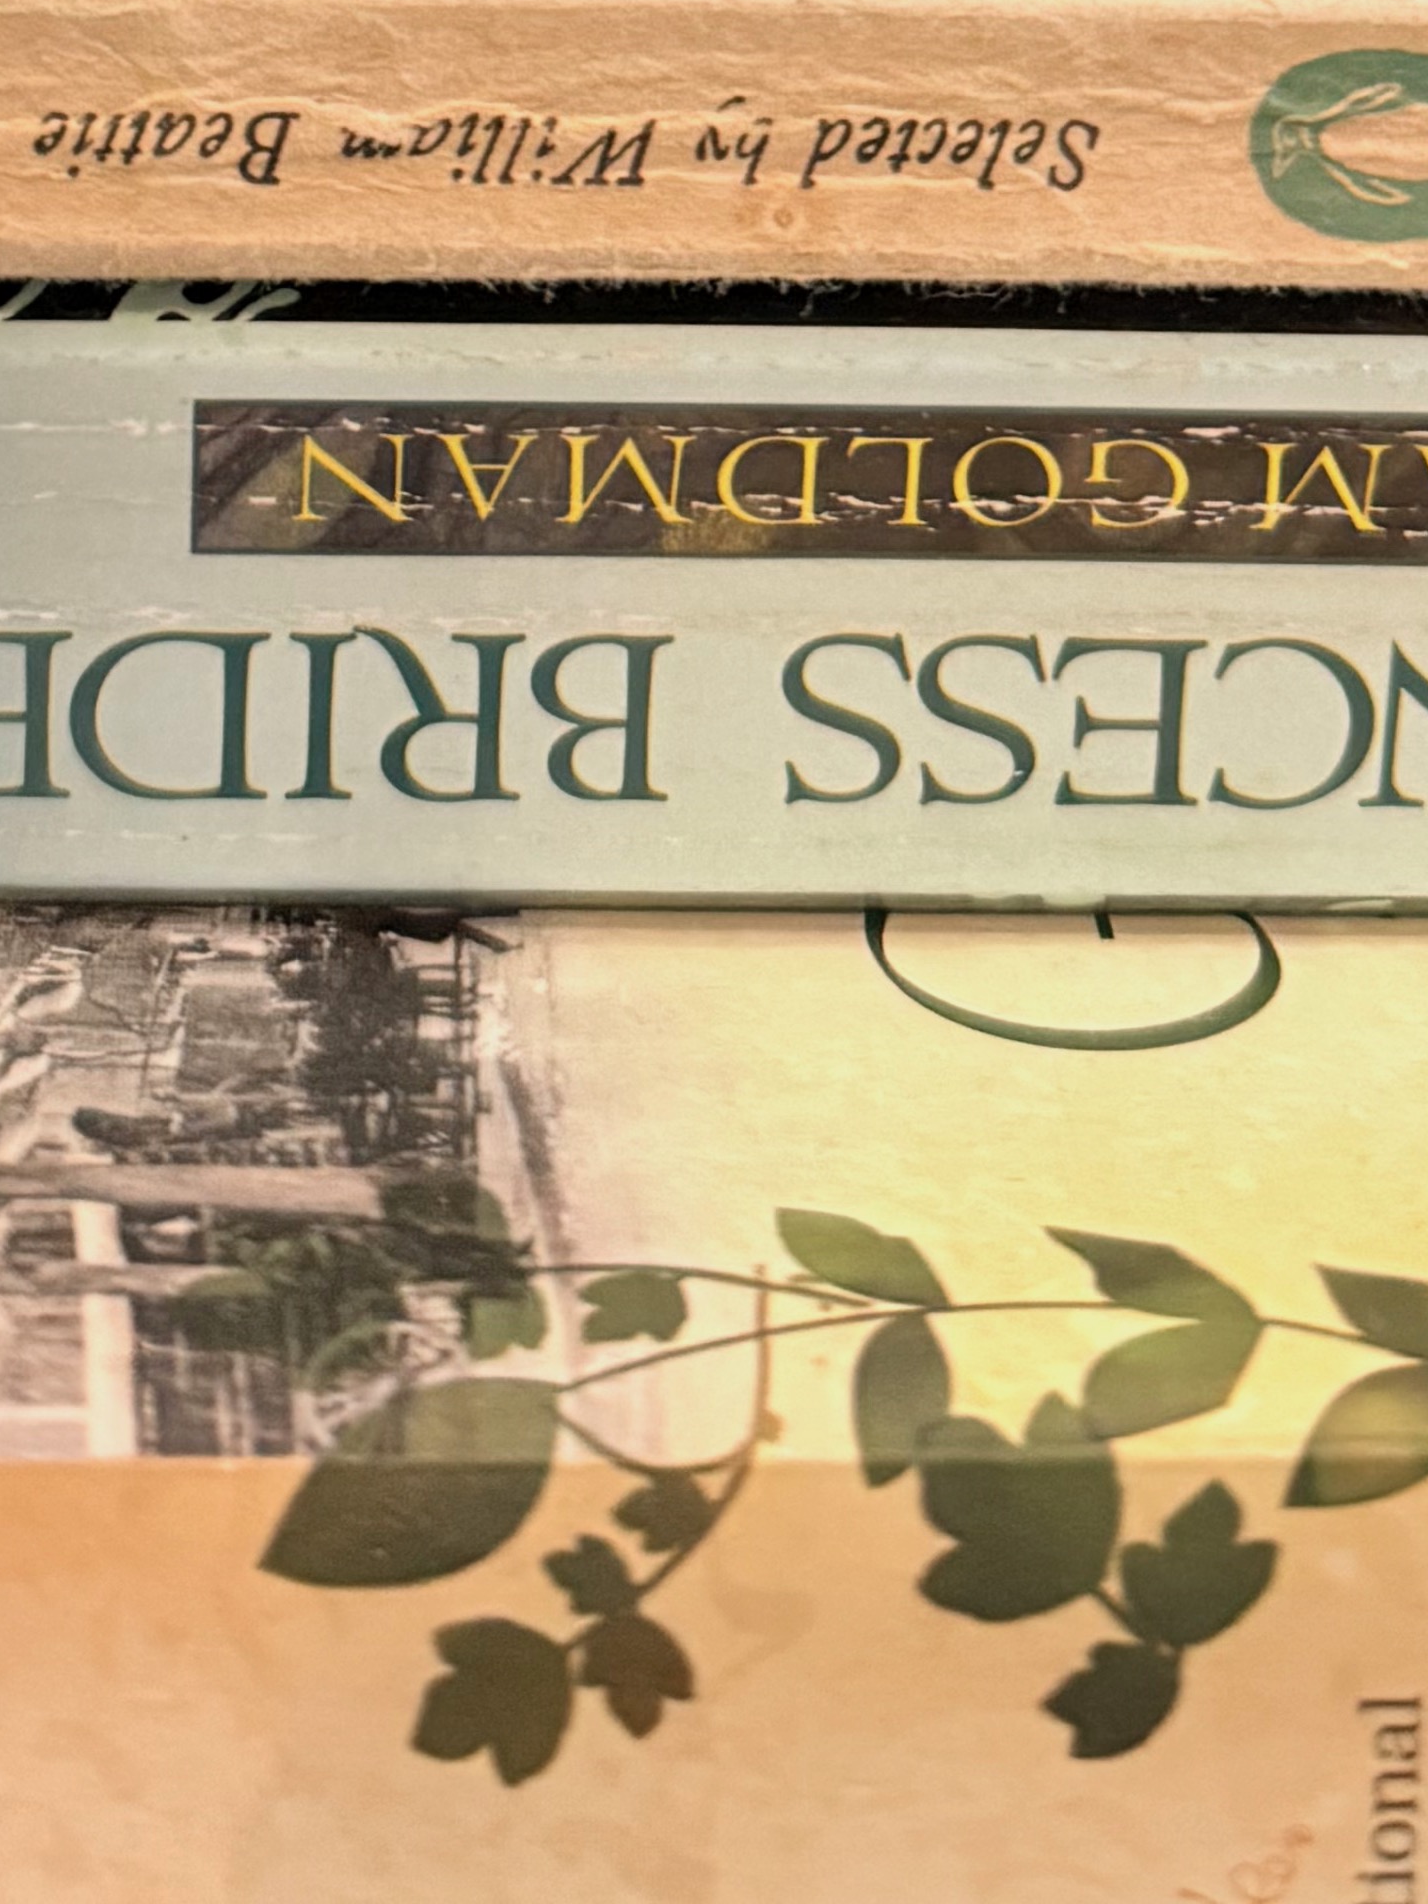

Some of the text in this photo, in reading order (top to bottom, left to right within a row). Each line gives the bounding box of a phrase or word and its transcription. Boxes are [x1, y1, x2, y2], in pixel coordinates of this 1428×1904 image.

[30, 95, 1100, 192] Selected by William Beattie
[290, 431, 1193, 532] GOLDMAN
